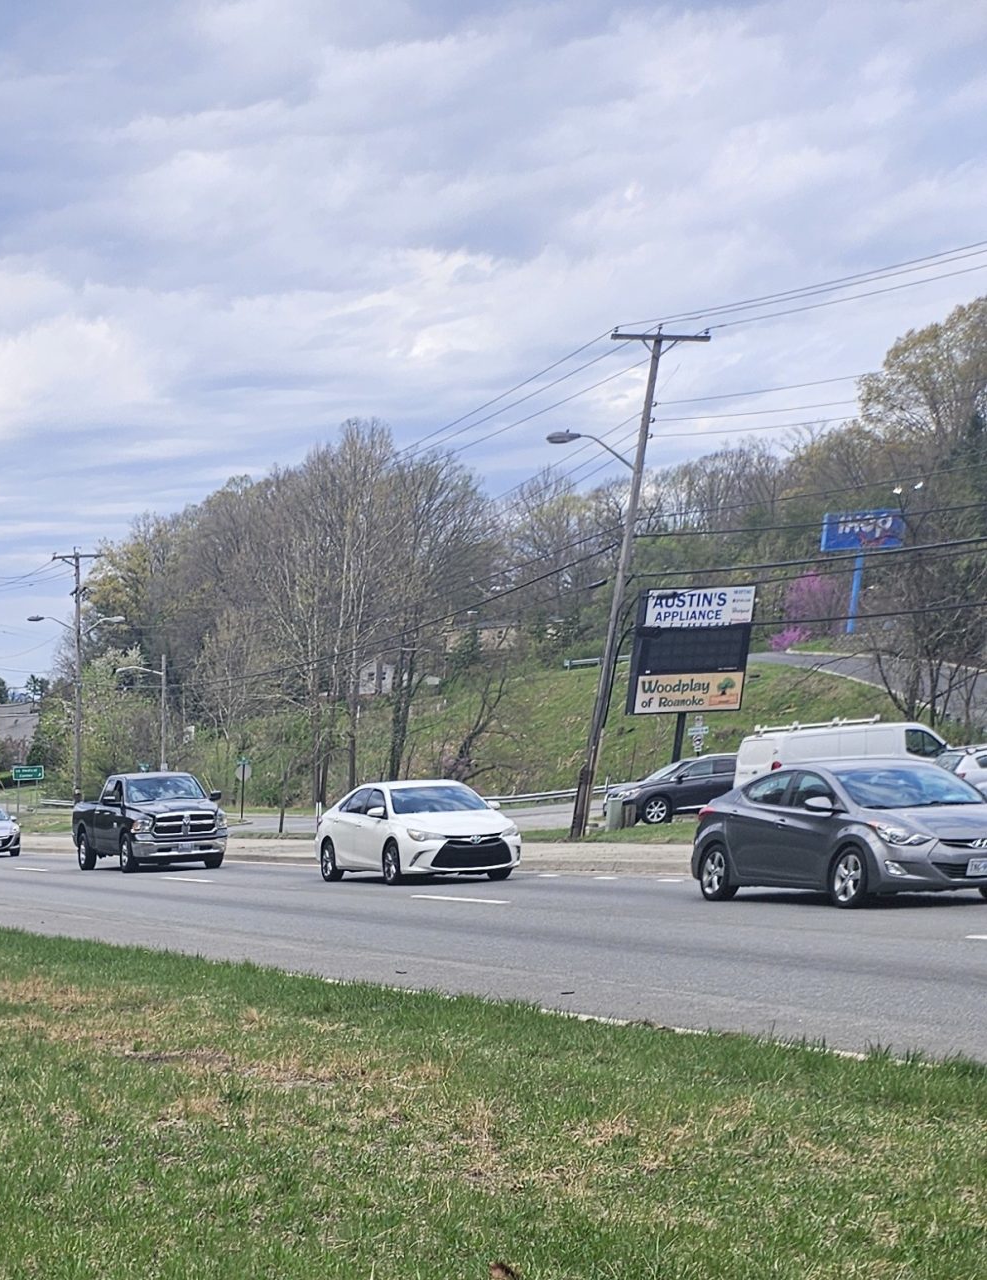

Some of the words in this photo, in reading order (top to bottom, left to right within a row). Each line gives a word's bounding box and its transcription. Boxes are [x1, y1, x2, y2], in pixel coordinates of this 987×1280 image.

[652, 592, 728, 609] AUSTIN'S
[654, 610, 723, 622] APPLIANCE
[641, 679, 710, 694] Woodplay
[641, 697, 653, 708] of
[658, 696, 705, 708] Roanoke
